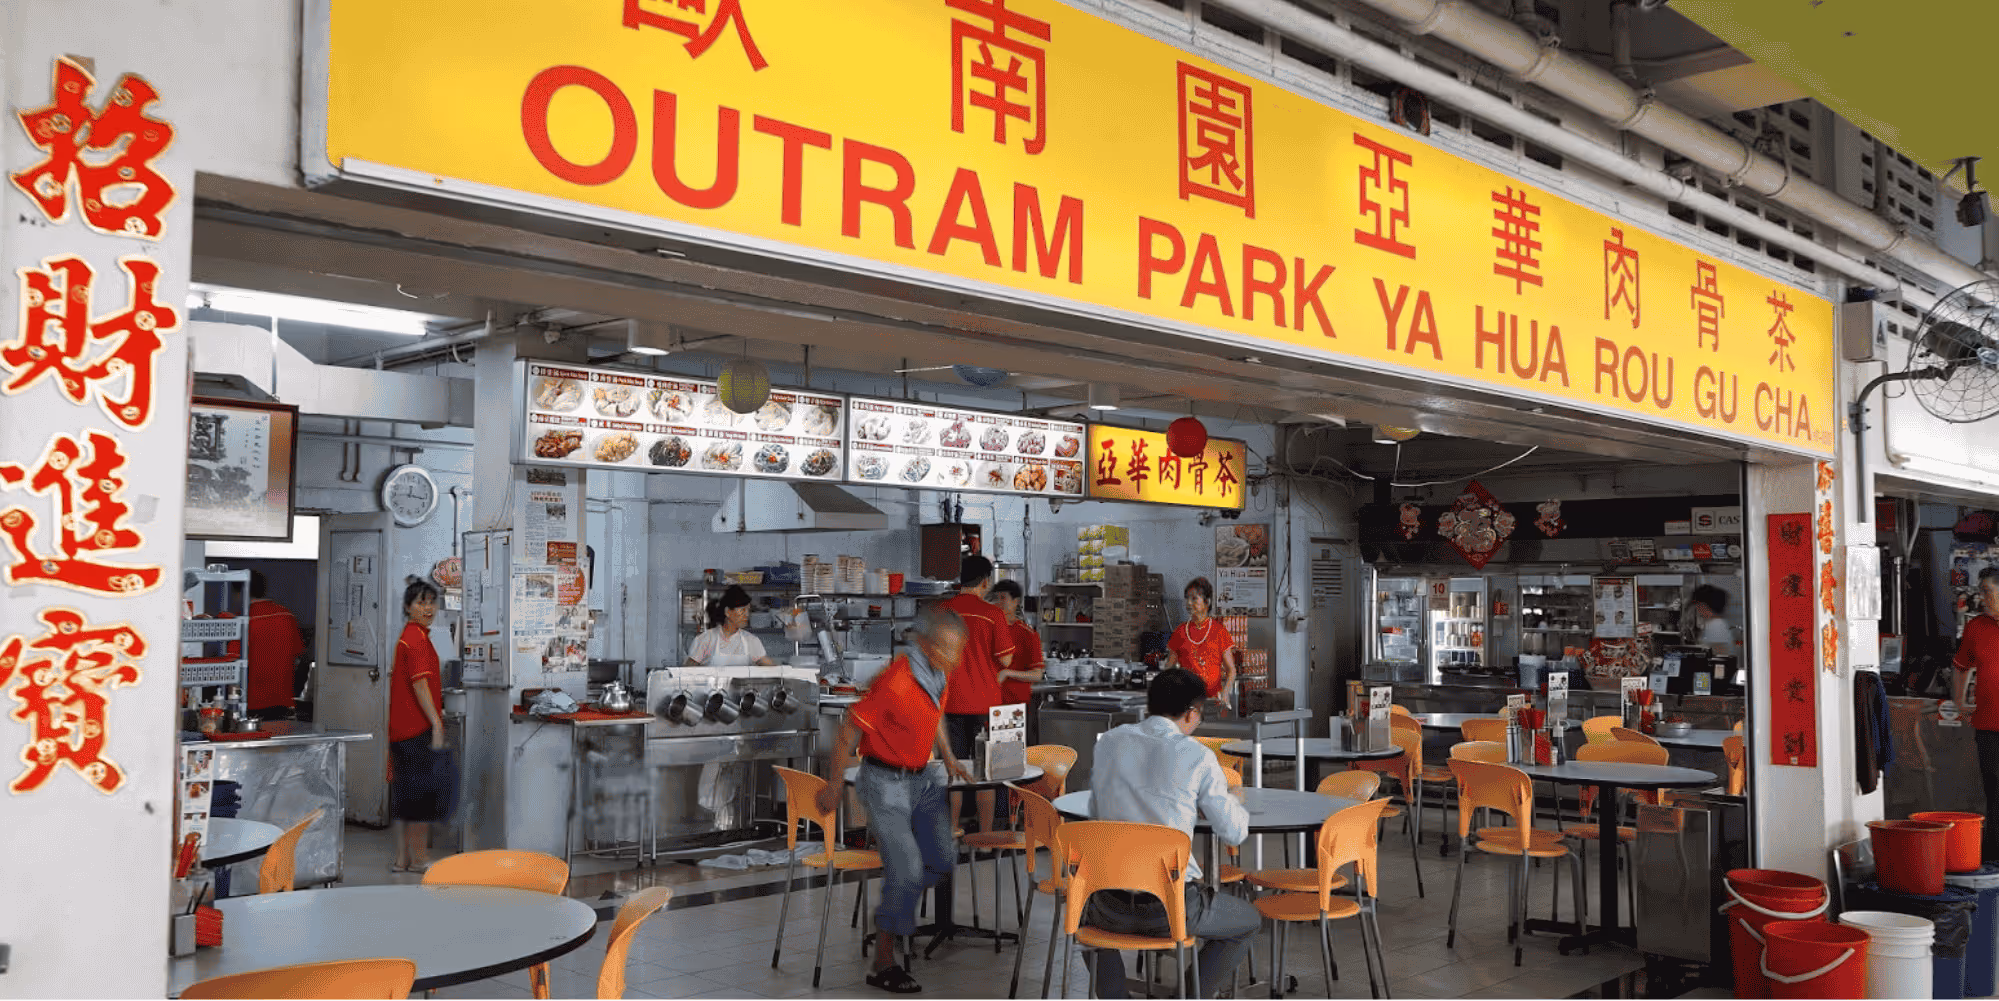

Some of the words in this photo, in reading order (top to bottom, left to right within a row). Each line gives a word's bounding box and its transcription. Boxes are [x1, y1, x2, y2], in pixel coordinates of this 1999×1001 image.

[520, 64, 1083, 285] OUTRAM
[1138, 215, 1337, 339] PARK
[1372, 277, 1444, 361] YA
[1474, 305, 1570, 388] HUA
[1594, 336, 1675, 410] ROU
[1693, 365, 1738, 424] GU
[1754, 381, 1812, 441] CHA
[0, 54, 182, 794] 招財進寶
[1096, 438, 1238, 498] 亞華肉骨茶
[1433, 582, 1445, 594] 10
